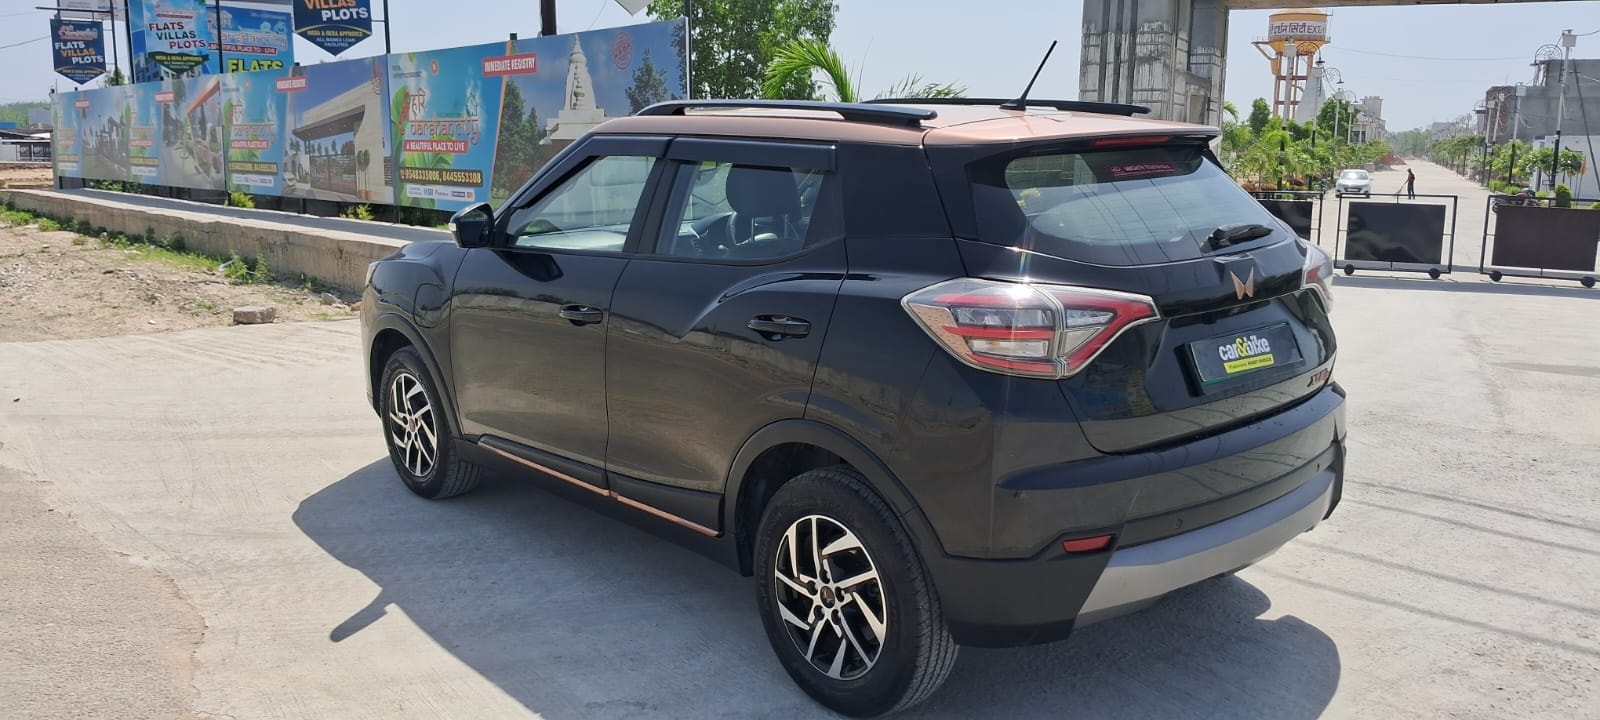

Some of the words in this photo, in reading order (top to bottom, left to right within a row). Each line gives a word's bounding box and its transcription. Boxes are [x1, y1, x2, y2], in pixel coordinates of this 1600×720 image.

[304, 0, 356, 9] VILLAS
[322, 8, 369, 21] PLOTS
[148, 22, 184, 31] FLATS
[156, 31, 196, 40] VILLAS
[55, 41, 85, 49] FLATS
[169, 40, 206, 49] PLOTS
[61, 48, 96, 57] VILLAS
[72, 56, 104, 64] PLOTS
[227, 59, 284, 72] FLATS
[484, 59, 511, 73] IMMEDIATE
[511, 57, 535, 70] REGISTRY
[410, 142, 433, 150] BEAUTIFUL
[447, 143, 454, 151] TO
[454, 143, 465, 151] LIVE
[1219, 335, 1271, 361] car&bike
